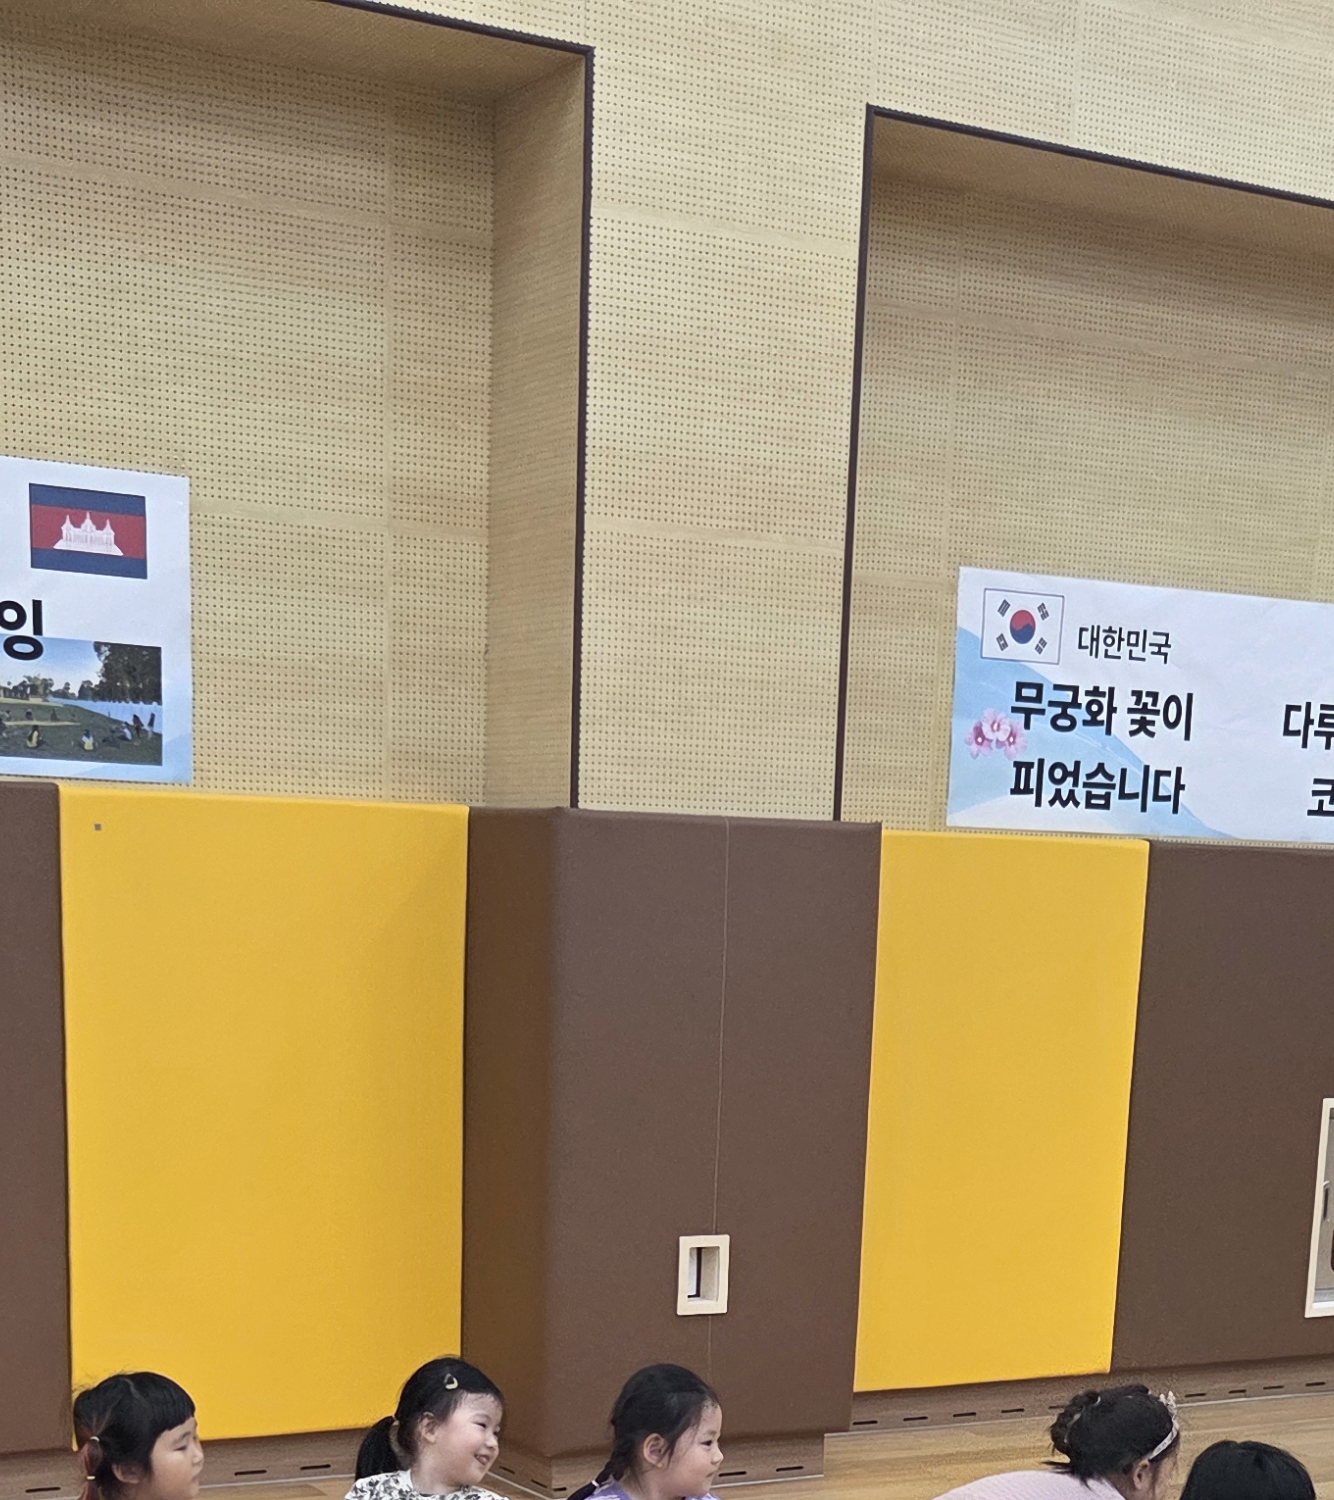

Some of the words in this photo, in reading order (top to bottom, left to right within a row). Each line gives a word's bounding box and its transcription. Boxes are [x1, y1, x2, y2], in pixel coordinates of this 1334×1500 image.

[1077, 624, 1172, 665] 대한민국
[1010, 681, 1118, 736] 무궁화
[1126, 689, 1194, 741] 꽃이
[1009, 757, 1186, 815] 피었습니다
